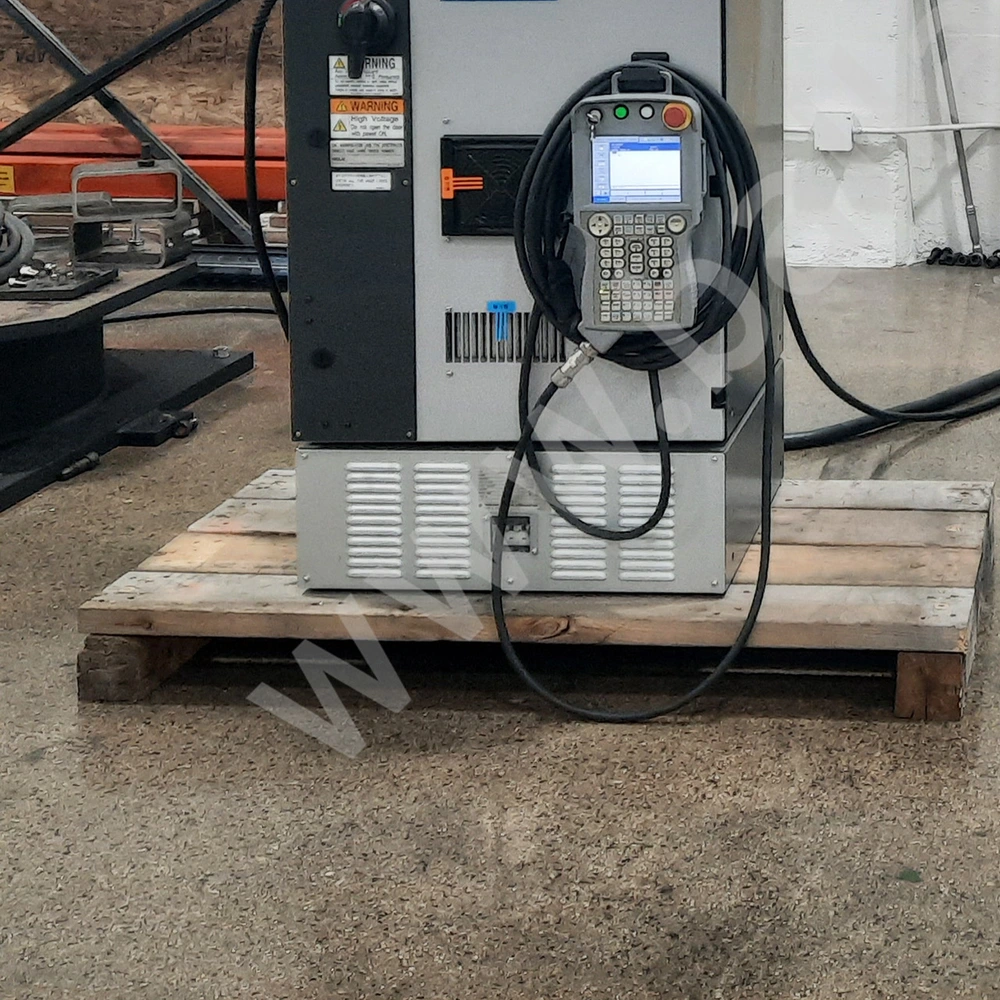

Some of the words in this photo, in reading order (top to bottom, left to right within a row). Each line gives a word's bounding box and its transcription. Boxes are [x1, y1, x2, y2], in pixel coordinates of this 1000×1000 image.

[365, 57, 396, 69] RNING
[350, 100, 399, 112] WARNING
[350, 116, 368, 124] High
[371, 115, 399, 124] Voltage
